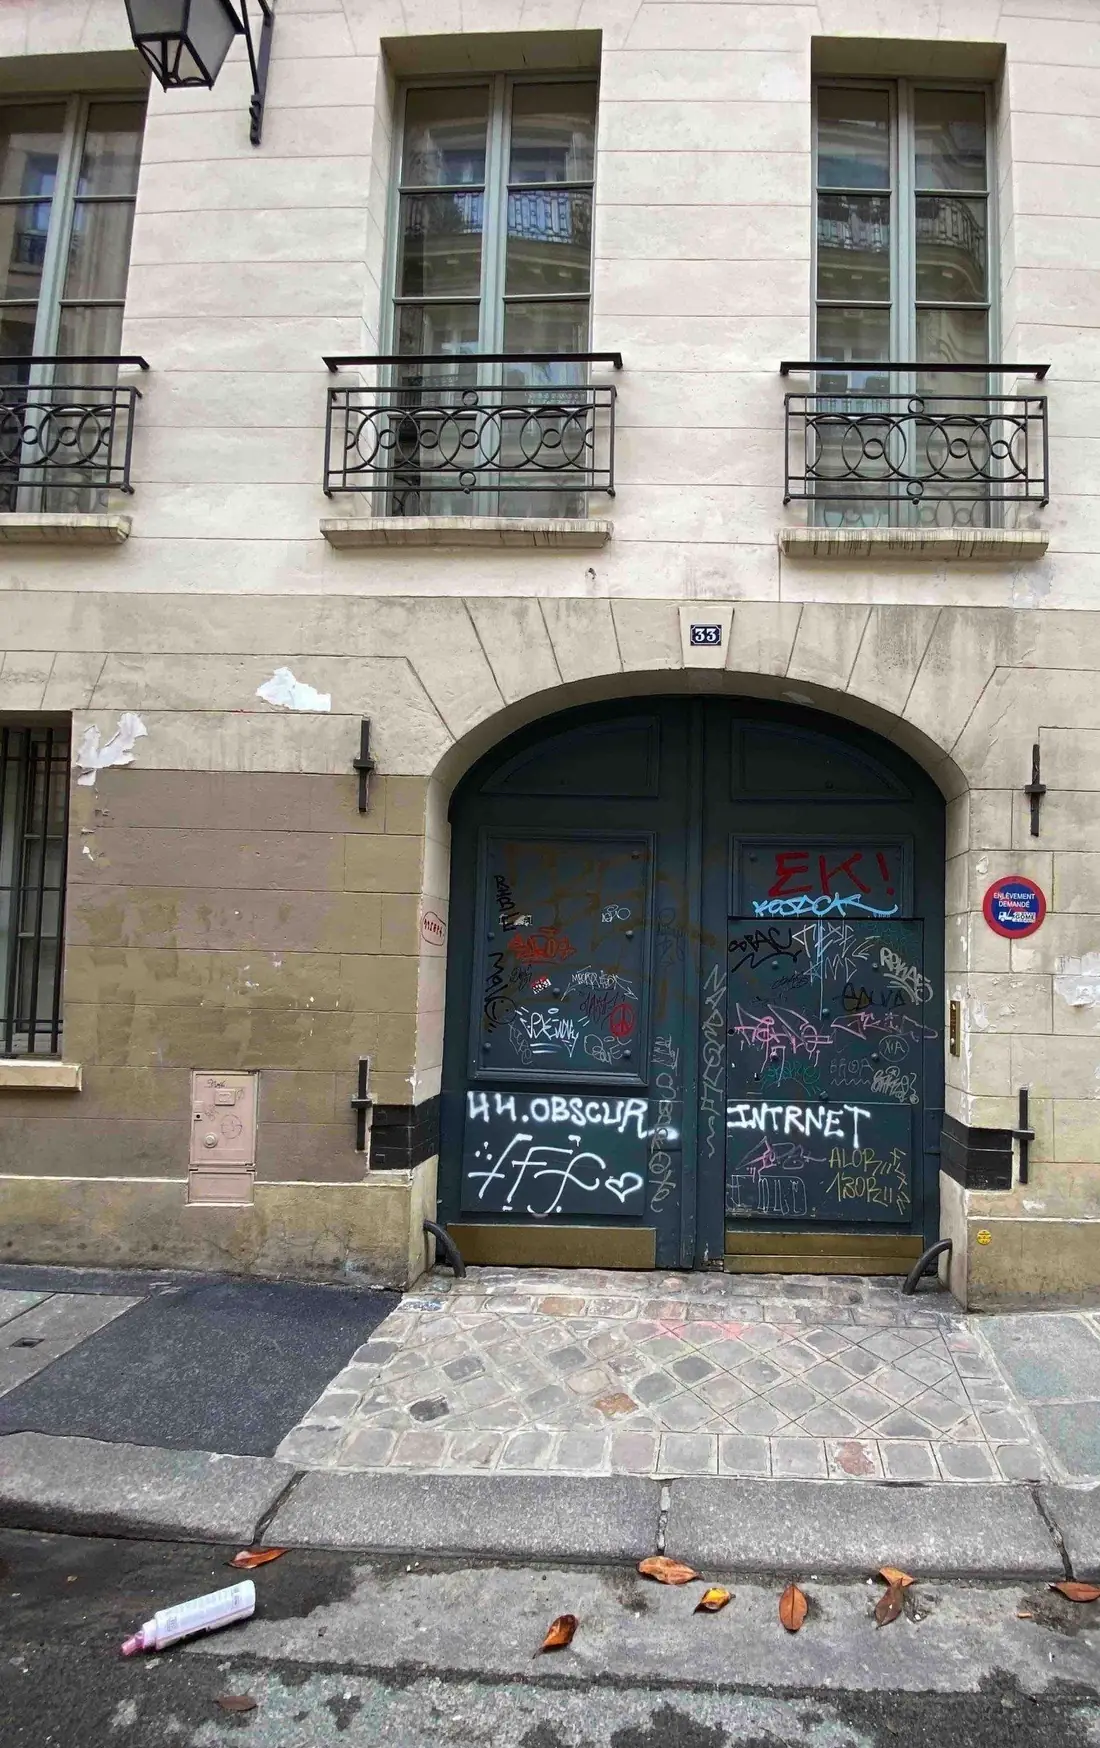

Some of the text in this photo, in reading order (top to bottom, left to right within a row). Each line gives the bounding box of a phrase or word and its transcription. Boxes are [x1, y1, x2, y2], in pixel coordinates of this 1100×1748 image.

[695, 628, 717, 642] 33
[768, 850, 895, 897] EK!
[993, 891, 1035, 900] ENLÈVEMENT
[998, 900, 1030, 908] DEMANDÉ
[727, 1103, 872, 1149] INTRNET
